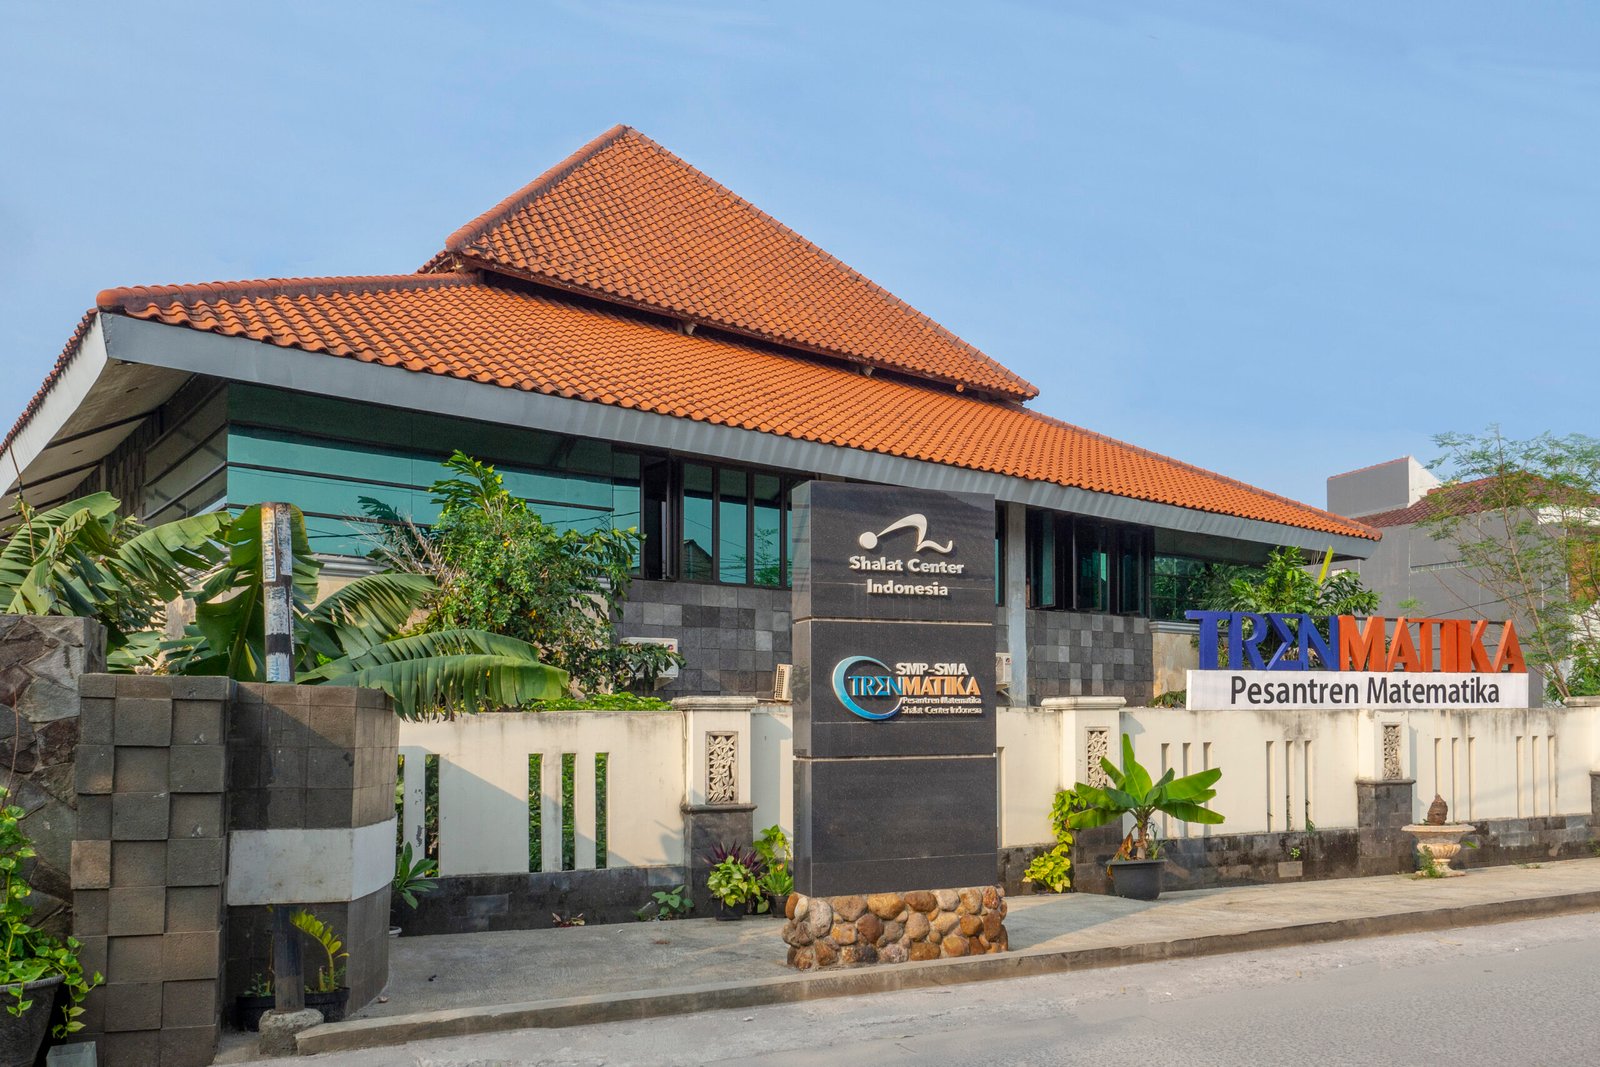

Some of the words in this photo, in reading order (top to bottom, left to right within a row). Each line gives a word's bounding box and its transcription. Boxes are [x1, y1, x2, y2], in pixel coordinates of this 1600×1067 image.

[849, 555, 904, 572] Shalat
[907, 558, 965, 574] Center
[866, 578, 949, 596] Indonesia
[896, 662, 969, 676] SMP-SMA
[1231, 675, 1359, 705] Pesantren
[1366, 676, 1500, 705] Matematika
[902, 696, 940, 704] Pesantren
[940, 696, 982, 704] Matematika
[924, 706, 950, 714] Center
[950, 706, 983, 715] Indonesia
